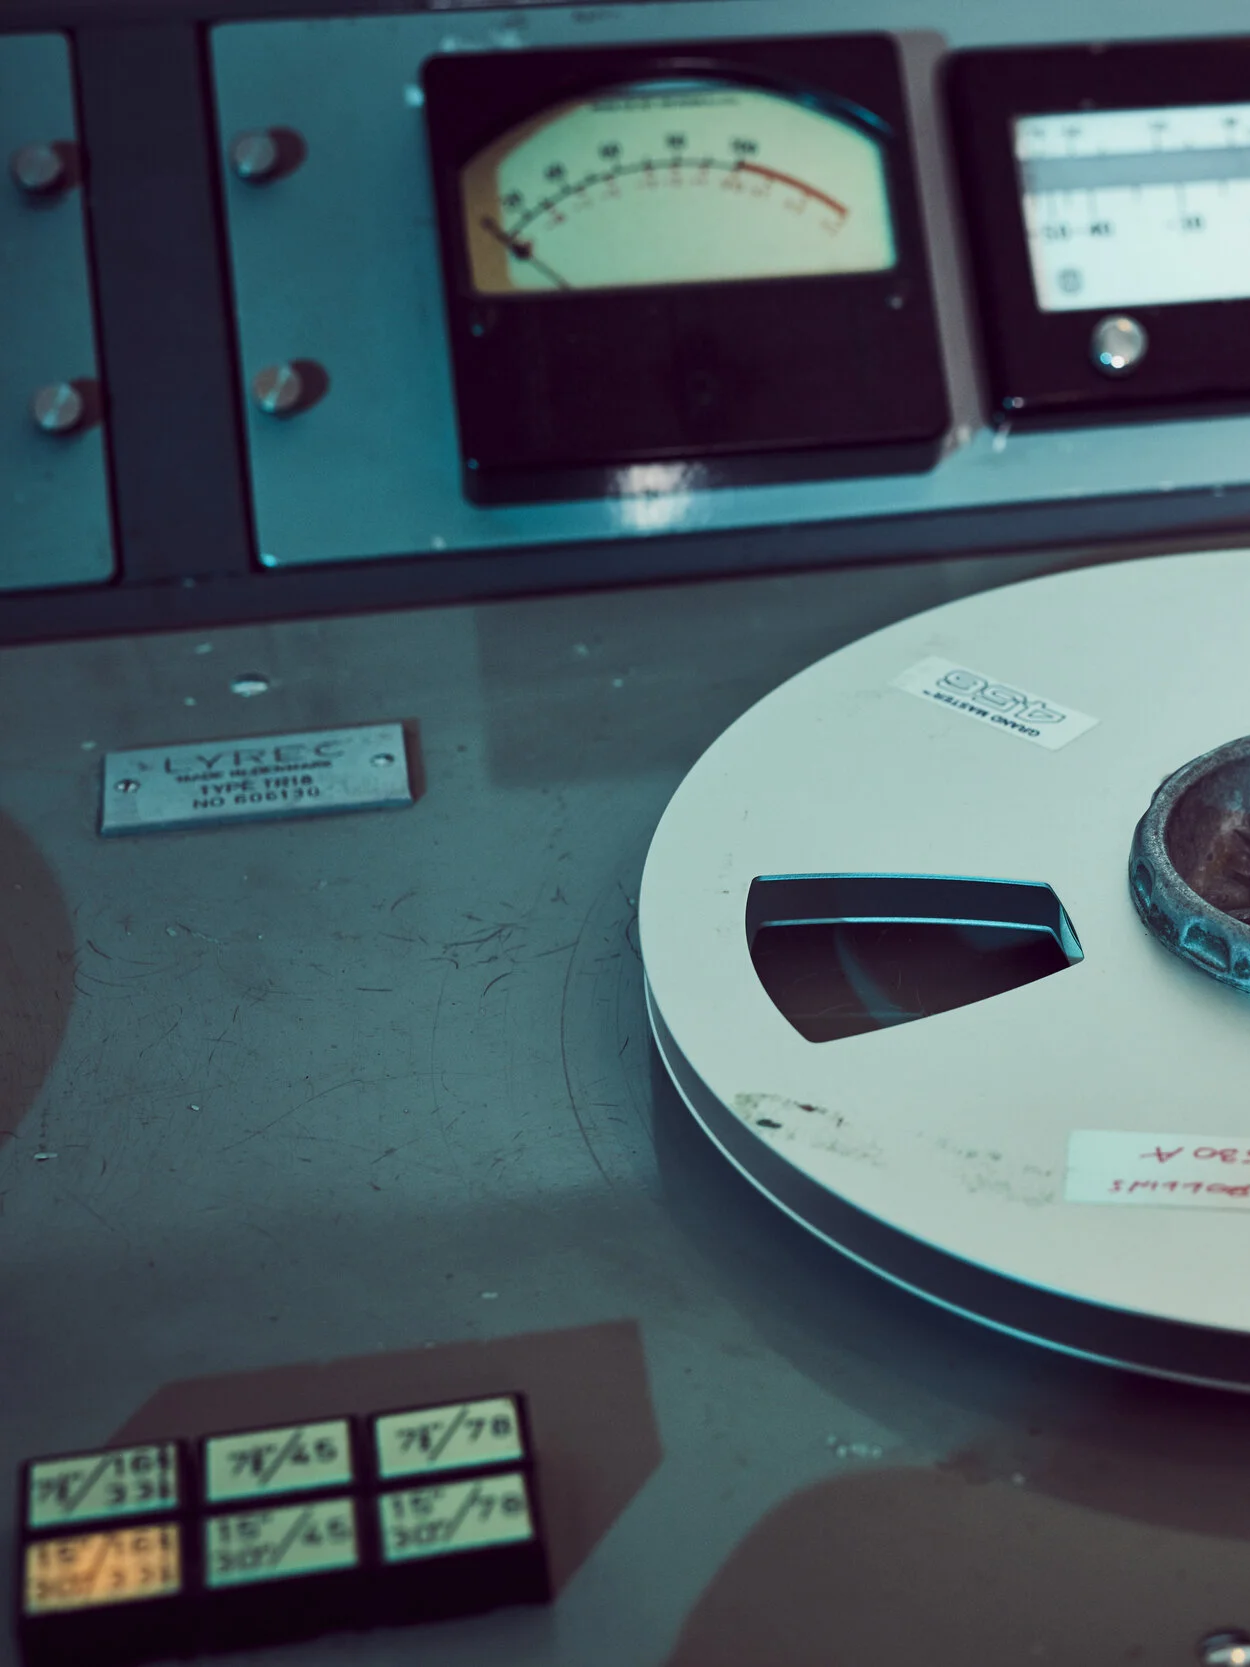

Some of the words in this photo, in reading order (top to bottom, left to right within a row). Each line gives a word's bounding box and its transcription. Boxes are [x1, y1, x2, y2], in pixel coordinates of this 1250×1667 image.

[936, 669, 1067, 724] 456
[990, 714, 1041, 738] GRAND
[201, 779, 255, 796] TYPE
[1139, 1146, 1186, 1164] A
